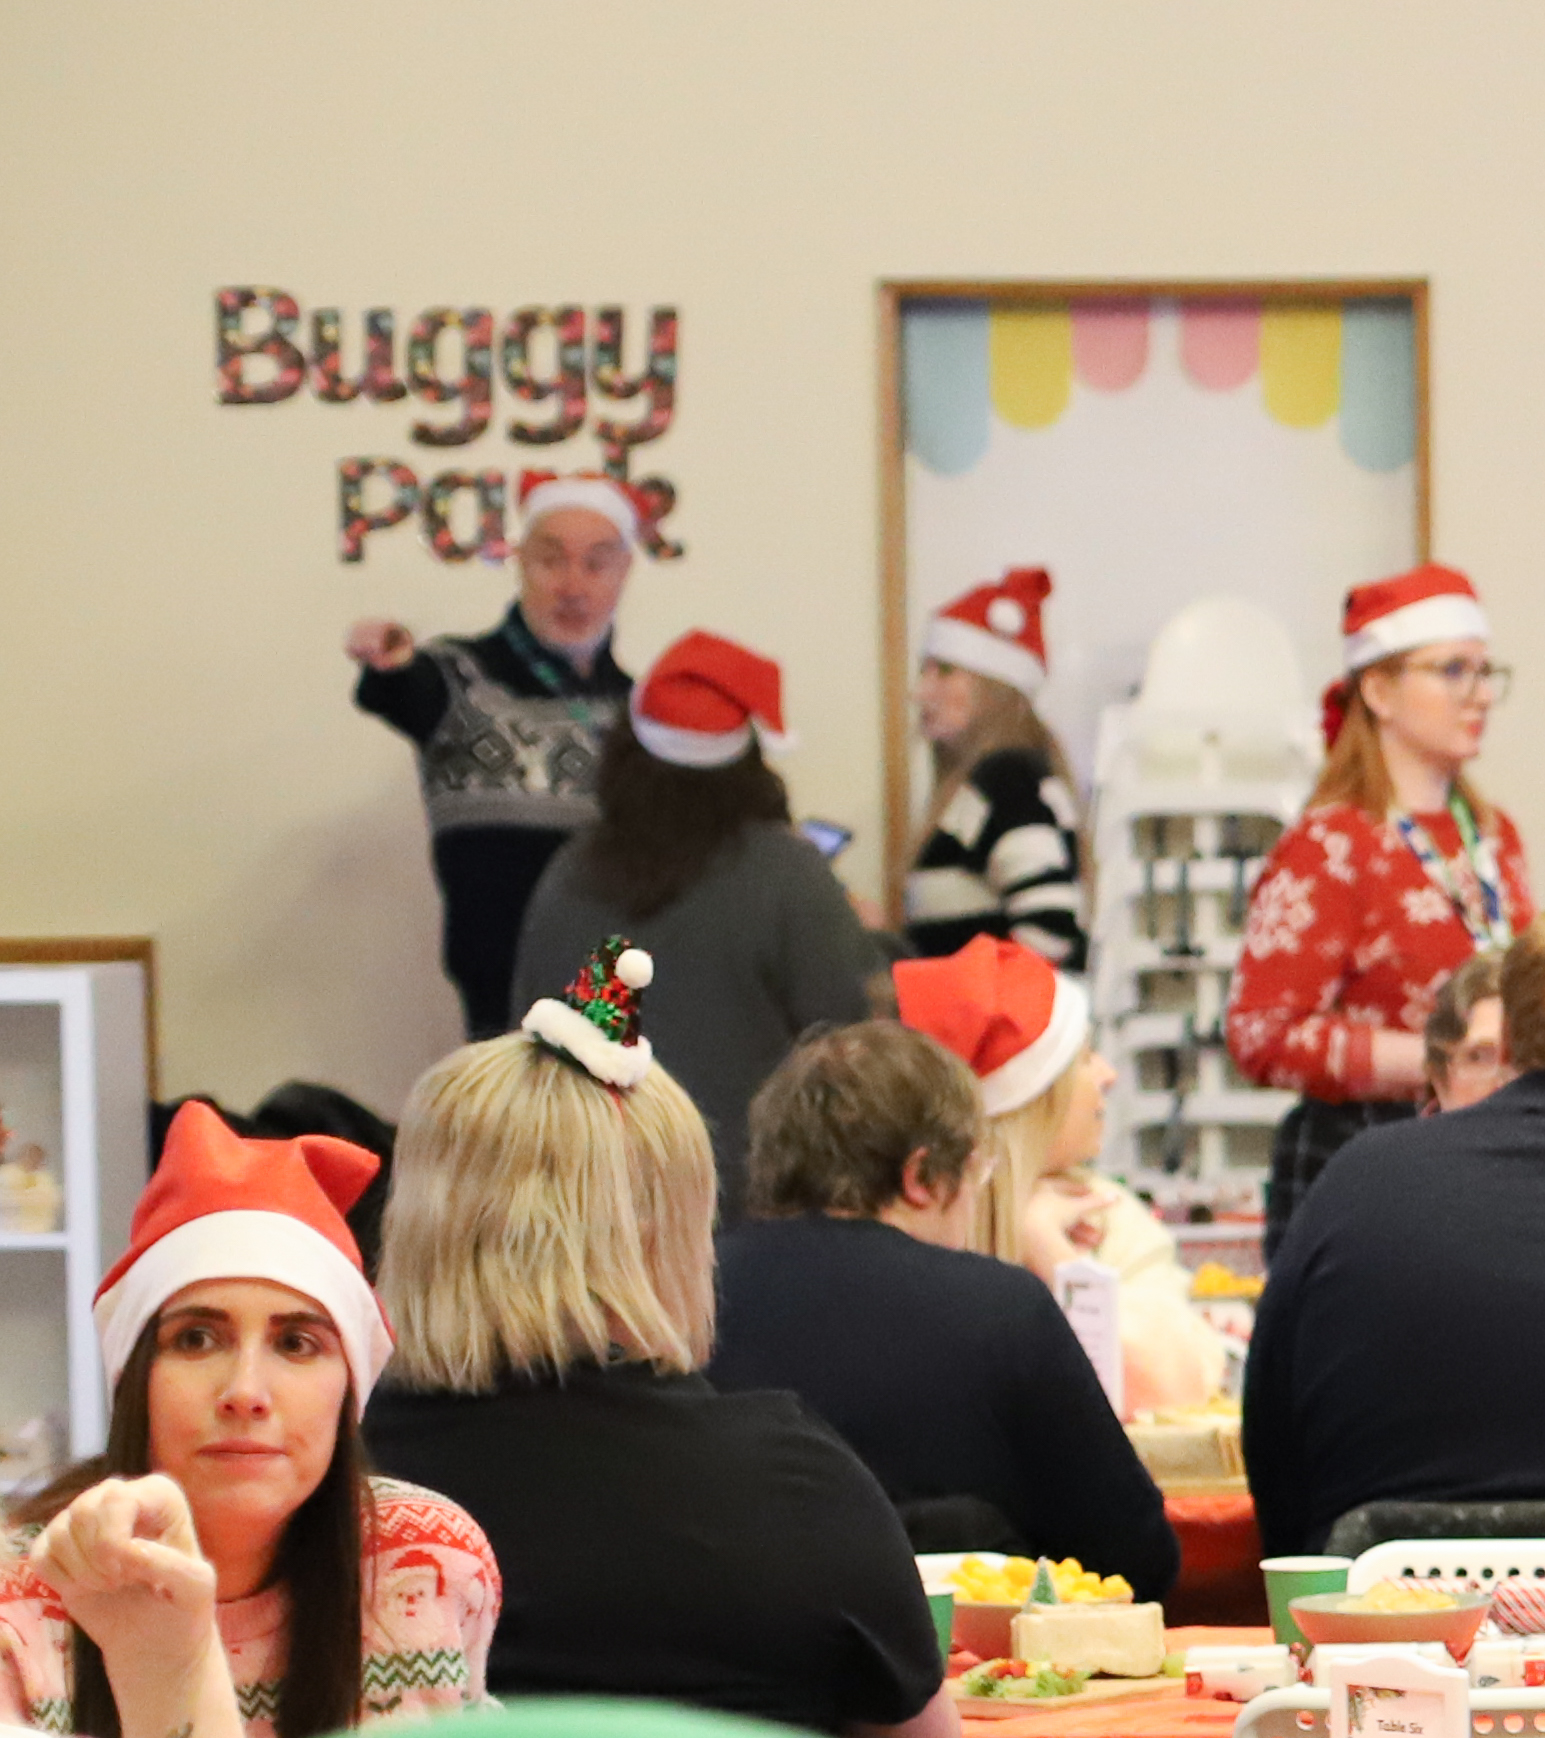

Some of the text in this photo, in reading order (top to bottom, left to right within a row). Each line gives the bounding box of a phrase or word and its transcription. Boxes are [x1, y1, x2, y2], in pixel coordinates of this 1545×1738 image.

[213, 284, 681, 448] Buggy
[337, 434, 686, 564] Pak
[1376, 1719, 1424, 1735] Table Six
